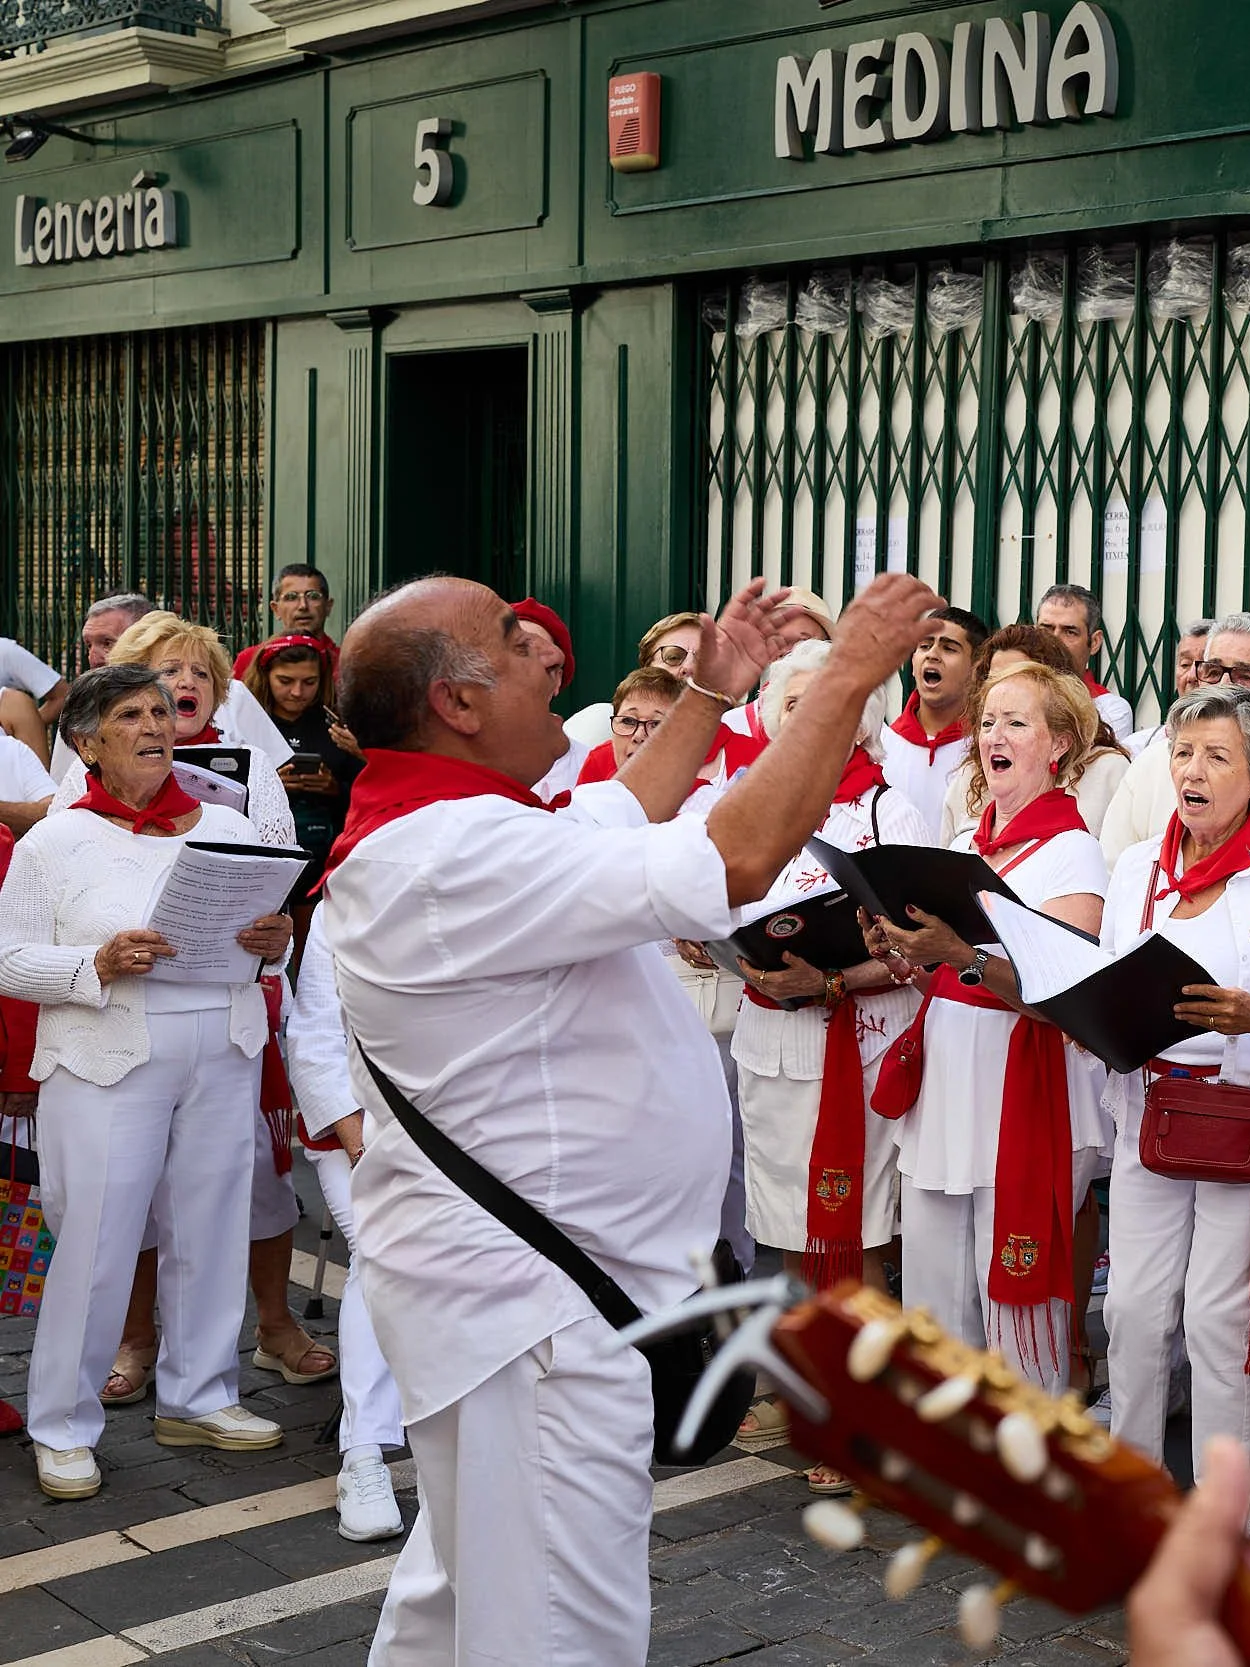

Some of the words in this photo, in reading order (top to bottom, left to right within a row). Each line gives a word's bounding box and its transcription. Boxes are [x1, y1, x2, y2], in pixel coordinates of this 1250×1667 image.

[775, 1, 1109, 158] MEDINA
[413, 117, 442, 206] 5
[15, 168, 168, 266] Lencería
